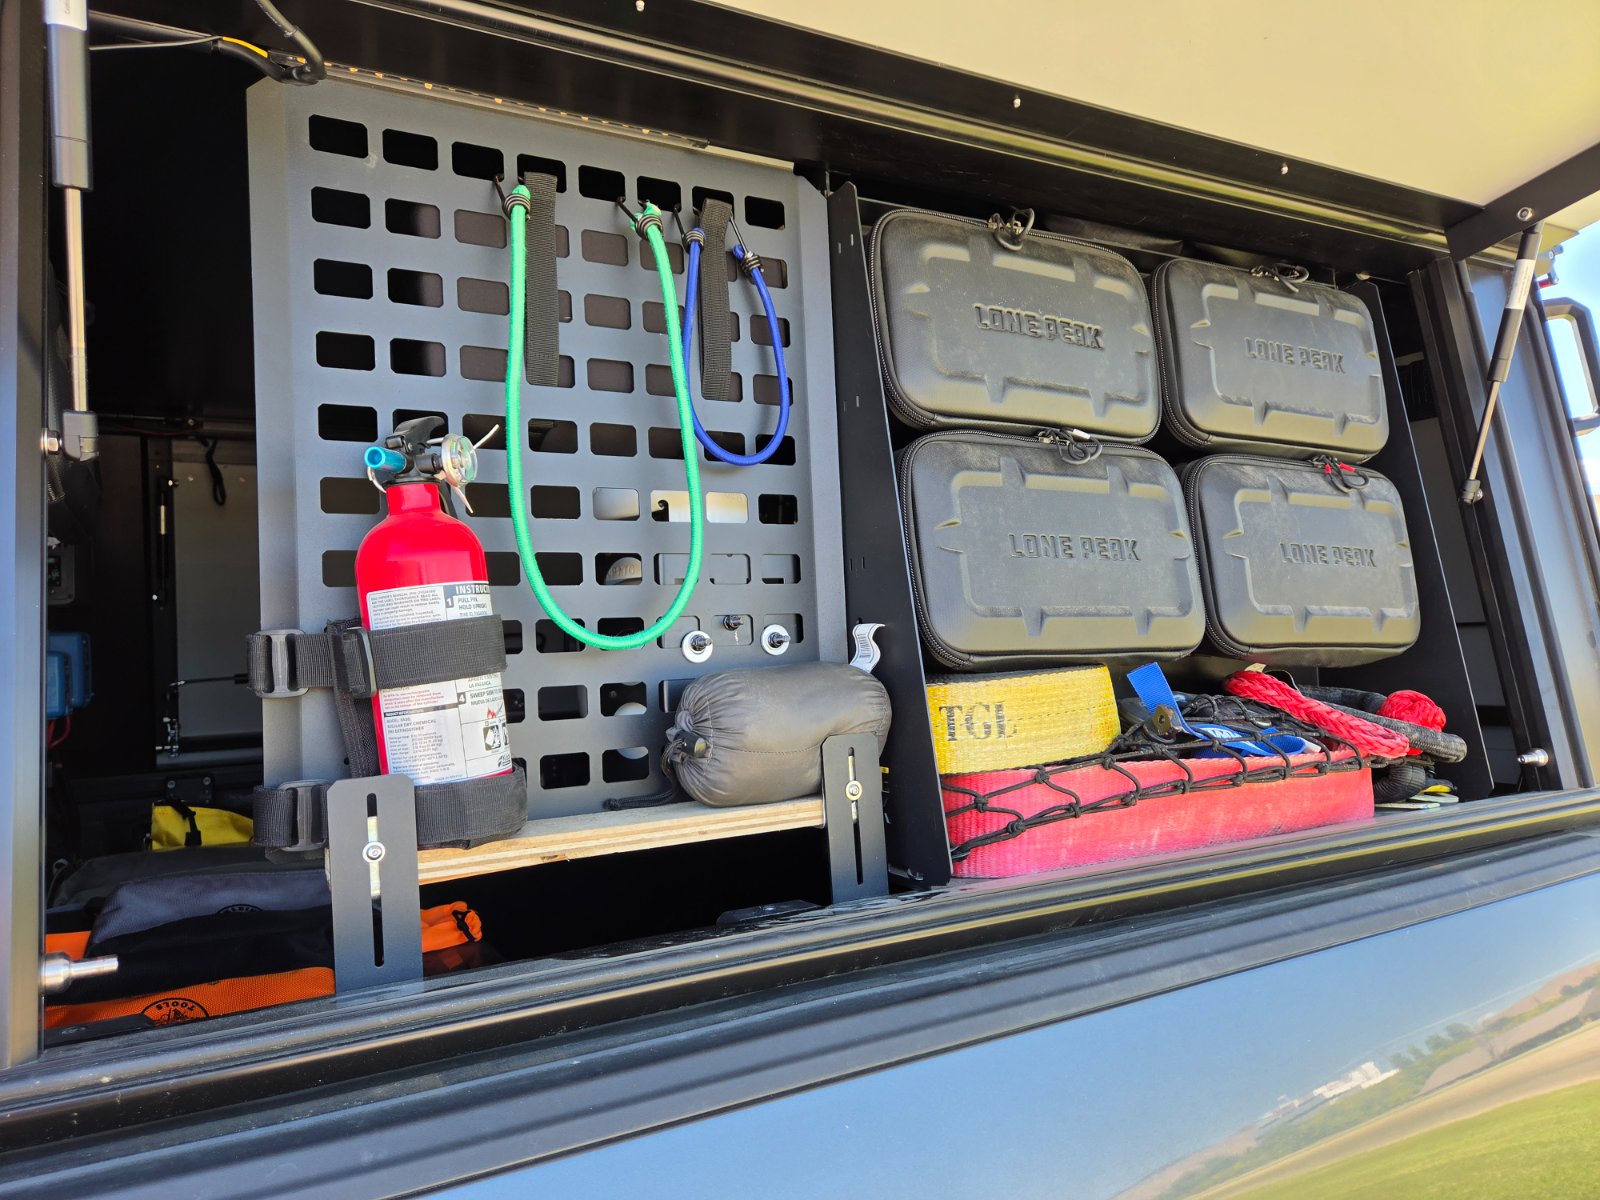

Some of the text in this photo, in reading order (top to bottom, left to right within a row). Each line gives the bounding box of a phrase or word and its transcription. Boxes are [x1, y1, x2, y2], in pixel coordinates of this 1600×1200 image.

[974, 303, 1104, 350] LONE PEAK
[1243, 337, 1345, 374] LONE PEAK
[1008, 533, 1141, 561] LONE PEAK
[1280, 542, 1377, 568] LONE PEAK
[446, 597, 453, 607] 1
[459, 693, 466, 703] 4
[938, 701, 1018, 742] TGL
